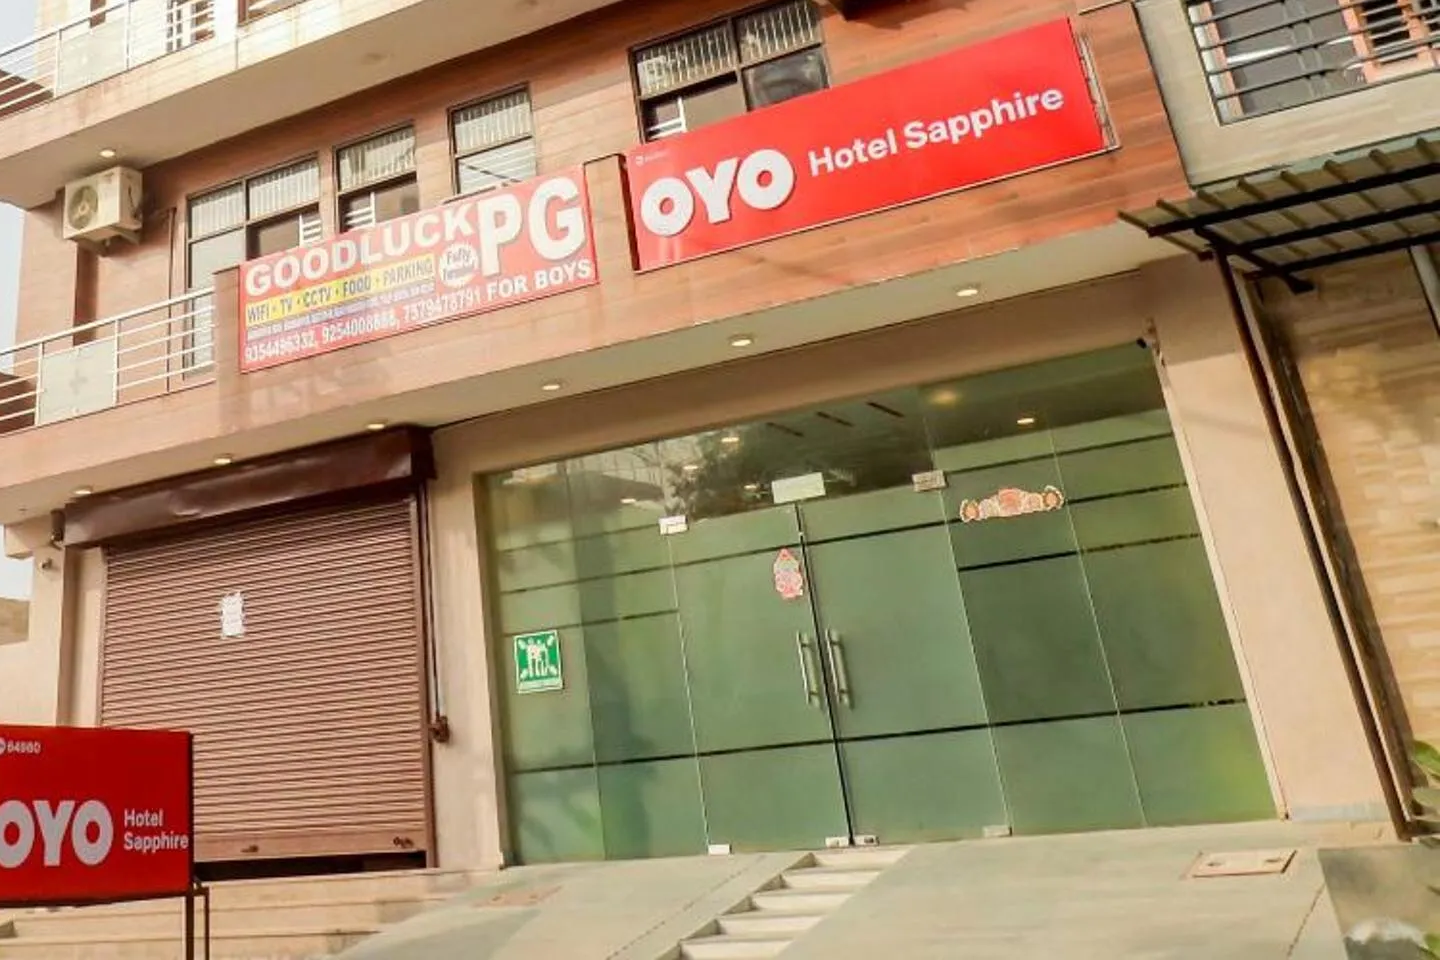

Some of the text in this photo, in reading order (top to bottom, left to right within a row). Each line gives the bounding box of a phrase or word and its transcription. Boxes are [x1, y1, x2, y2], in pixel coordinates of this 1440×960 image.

[640, 87, 1065, 237] OYO Hotel Sapphire
[244, 176, 586, 297] GOODLUCK PG
[247, 304, 270, 324] WIFI
[279, 297, 293, 316] TV
[302, 286, 331, 307] CCTV
[343, 275, 371, 297] FOOD
[382, 257, 434, 286] PARKING
[486, 274, 528, 302] FOR
[533, 257, 594, 289] BOYS
[123, 808, 164, 828] Hotel
[123, 830, 190, 856] Sapphire
